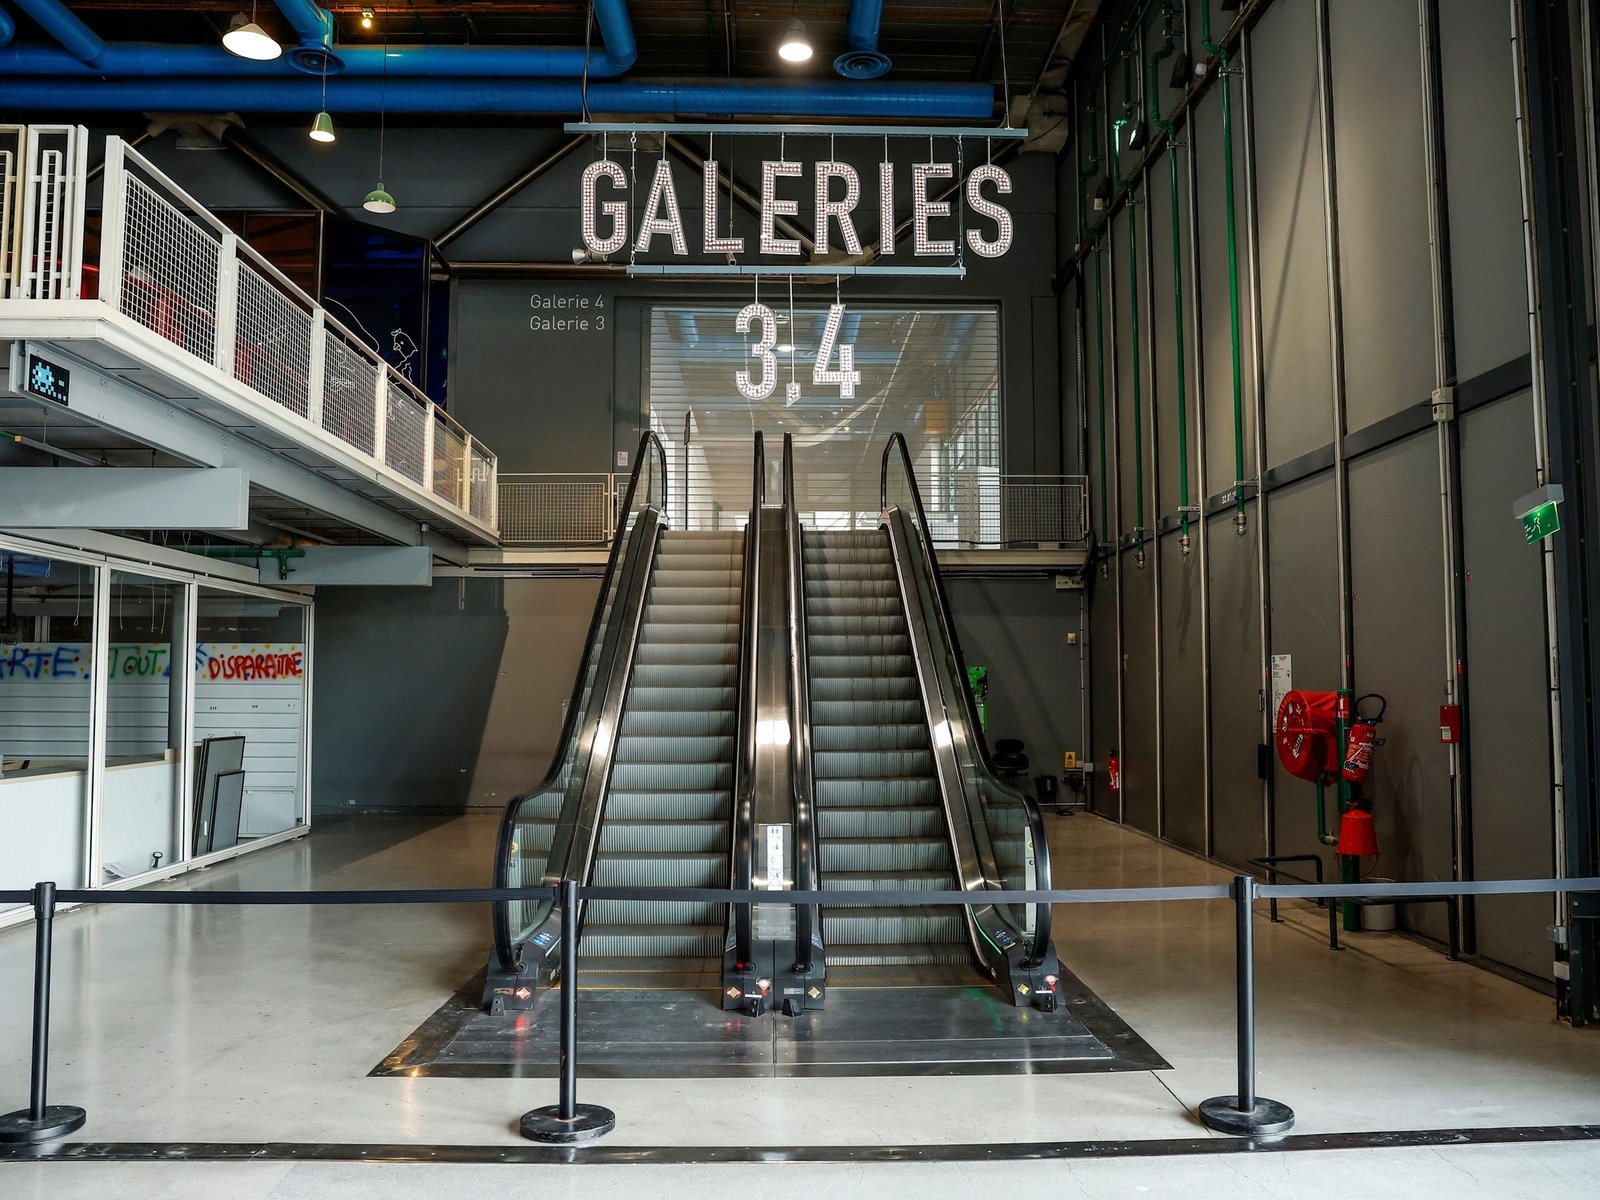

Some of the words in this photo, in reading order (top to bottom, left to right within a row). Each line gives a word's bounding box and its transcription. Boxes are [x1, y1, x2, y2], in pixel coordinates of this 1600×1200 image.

[581, 159, 1014, 258] GALERIES
[530, 294, 589, 309] Galerie
[594, 294, 605, 309] 4
[529, 315, 589, 331] Galerie
[595, 315, 605, 331] 3
[108, 646, 166, 678] TOUT
